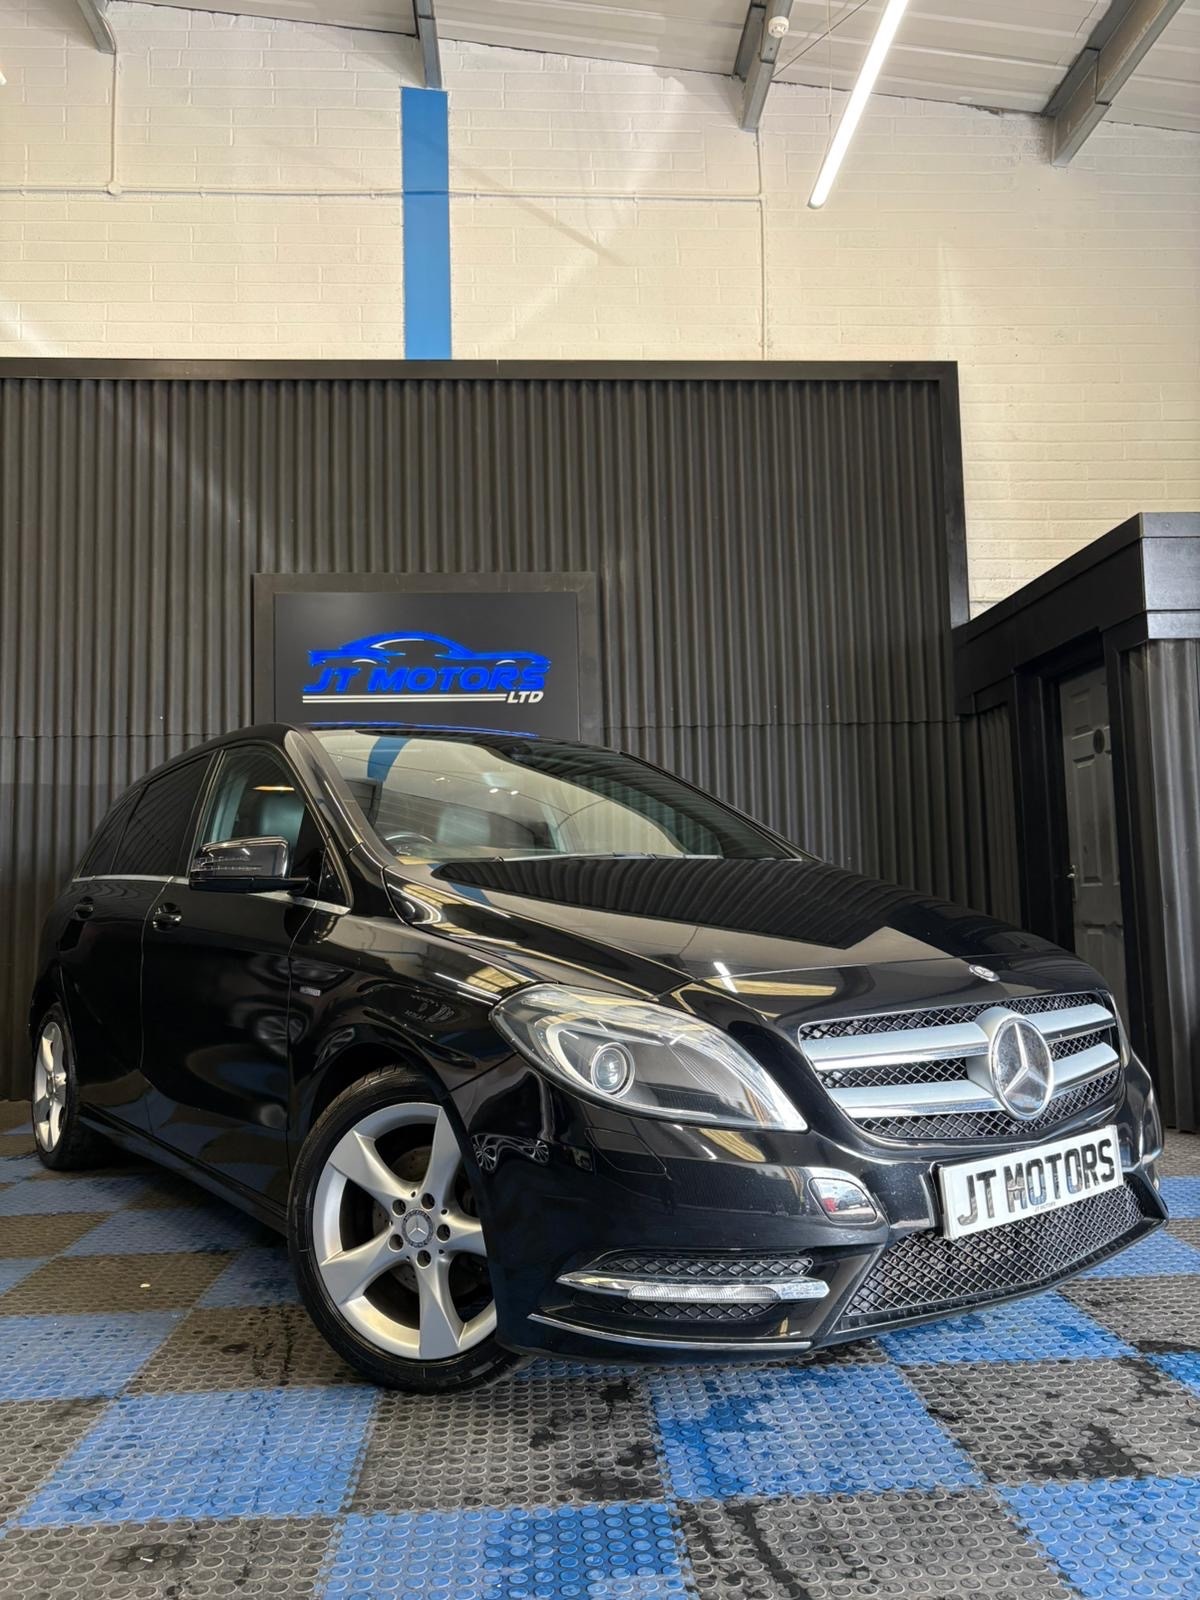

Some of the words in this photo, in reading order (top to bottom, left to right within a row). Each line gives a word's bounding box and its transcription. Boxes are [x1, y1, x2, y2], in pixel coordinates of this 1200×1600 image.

[303, 667, 360, 692] JT
[367, 666, 546, 692] MOTORS
[507, 691, 544, 704] LTD
[957, 1169, 997, 1226] JT
[1003, 1138, 1115, 1213] MOTORS
